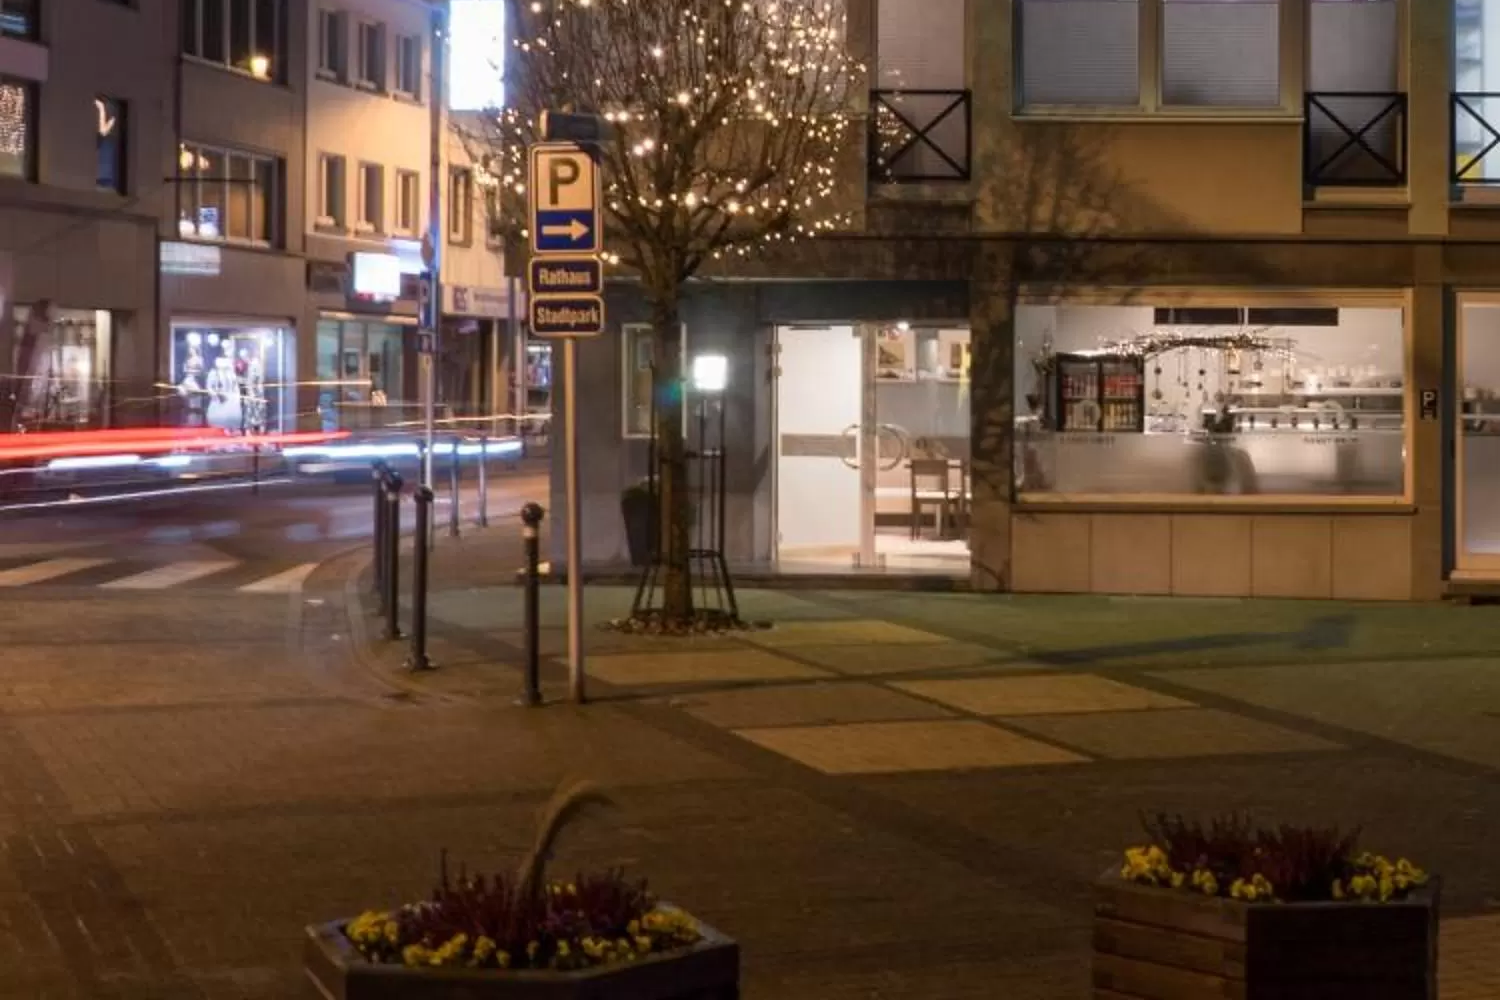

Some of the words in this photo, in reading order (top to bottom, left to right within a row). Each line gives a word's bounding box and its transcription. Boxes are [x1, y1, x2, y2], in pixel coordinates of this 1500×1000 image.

[549, 157, 581, 206] P
[539, 267, 591, 286] Rathaus
[537, 307, 599, 328] Stadtpark
